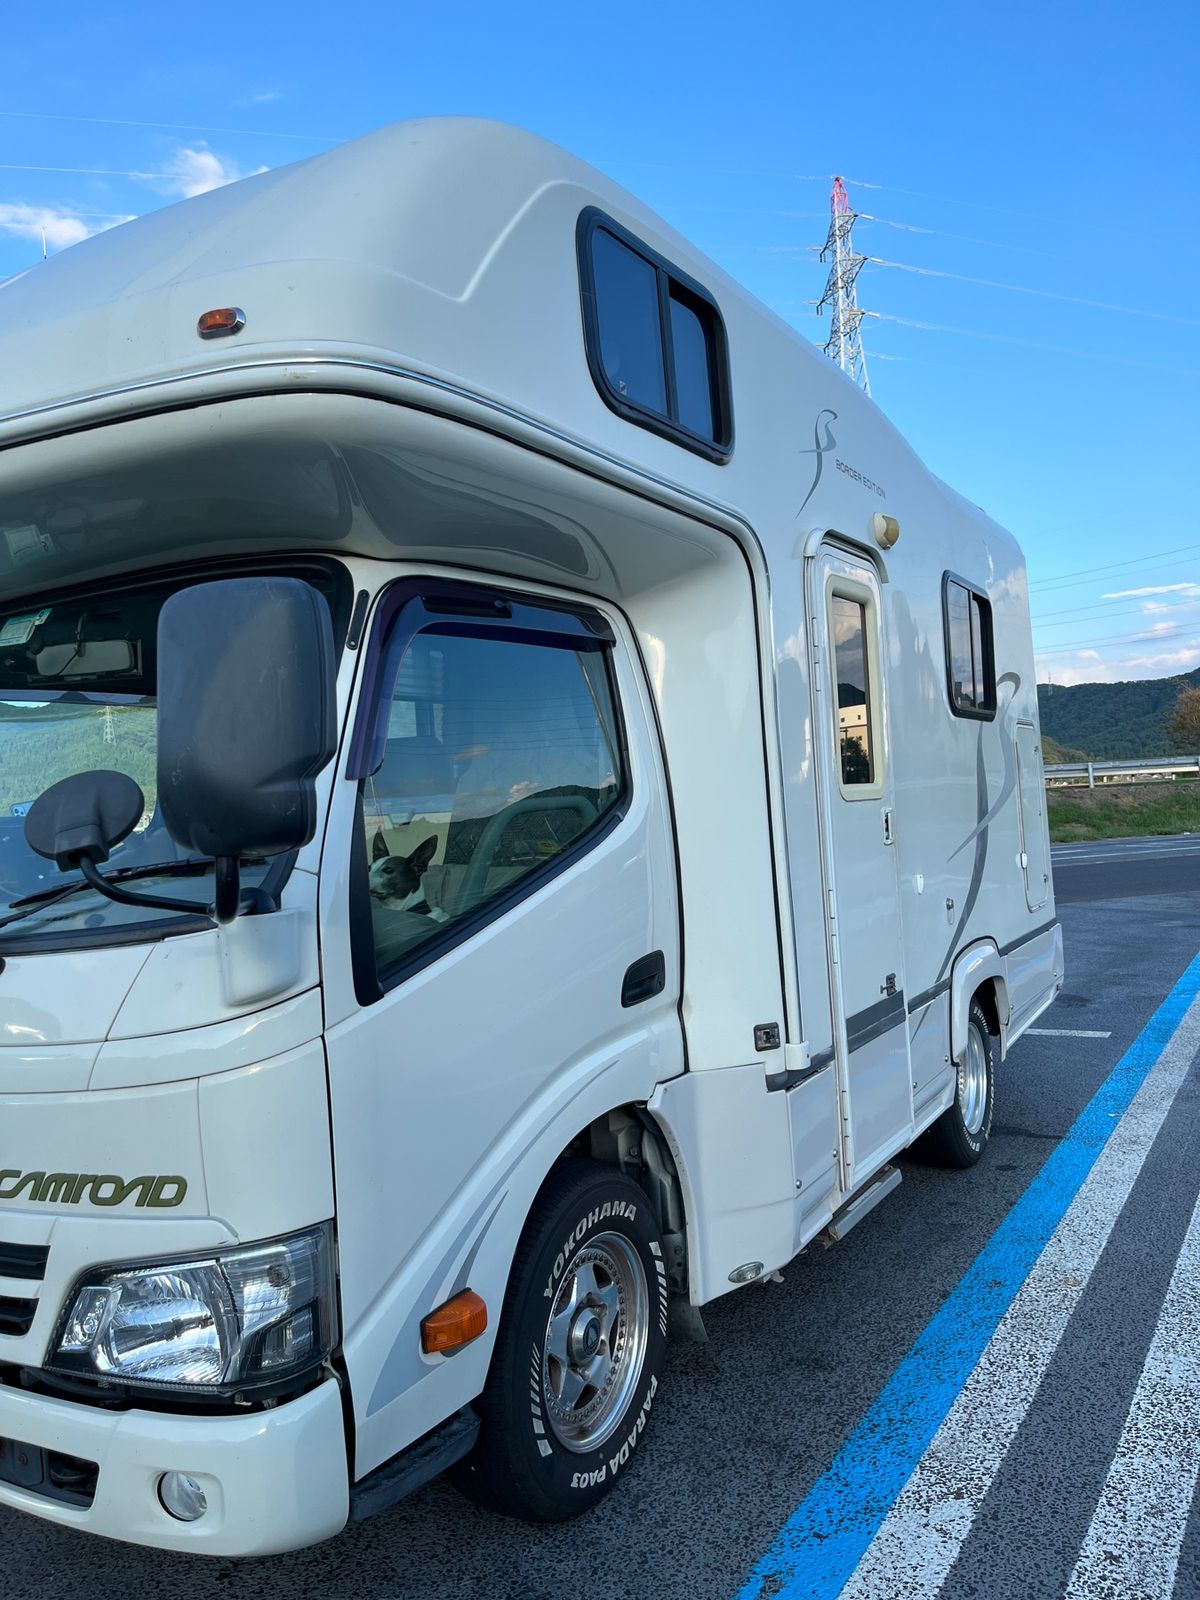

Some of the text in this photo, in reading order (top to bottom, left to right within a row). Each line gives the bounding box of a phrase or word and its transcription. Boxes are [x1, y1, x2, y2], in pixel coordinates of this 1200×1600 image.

[836, 459, 886, 499] BORDER EDITION
[0, 1169, 187, 1207] CAMROAD
[543, 1201, 637, 1298] YOKOHAMA
[570, 1375, 658, 1488] PARADA PA03
